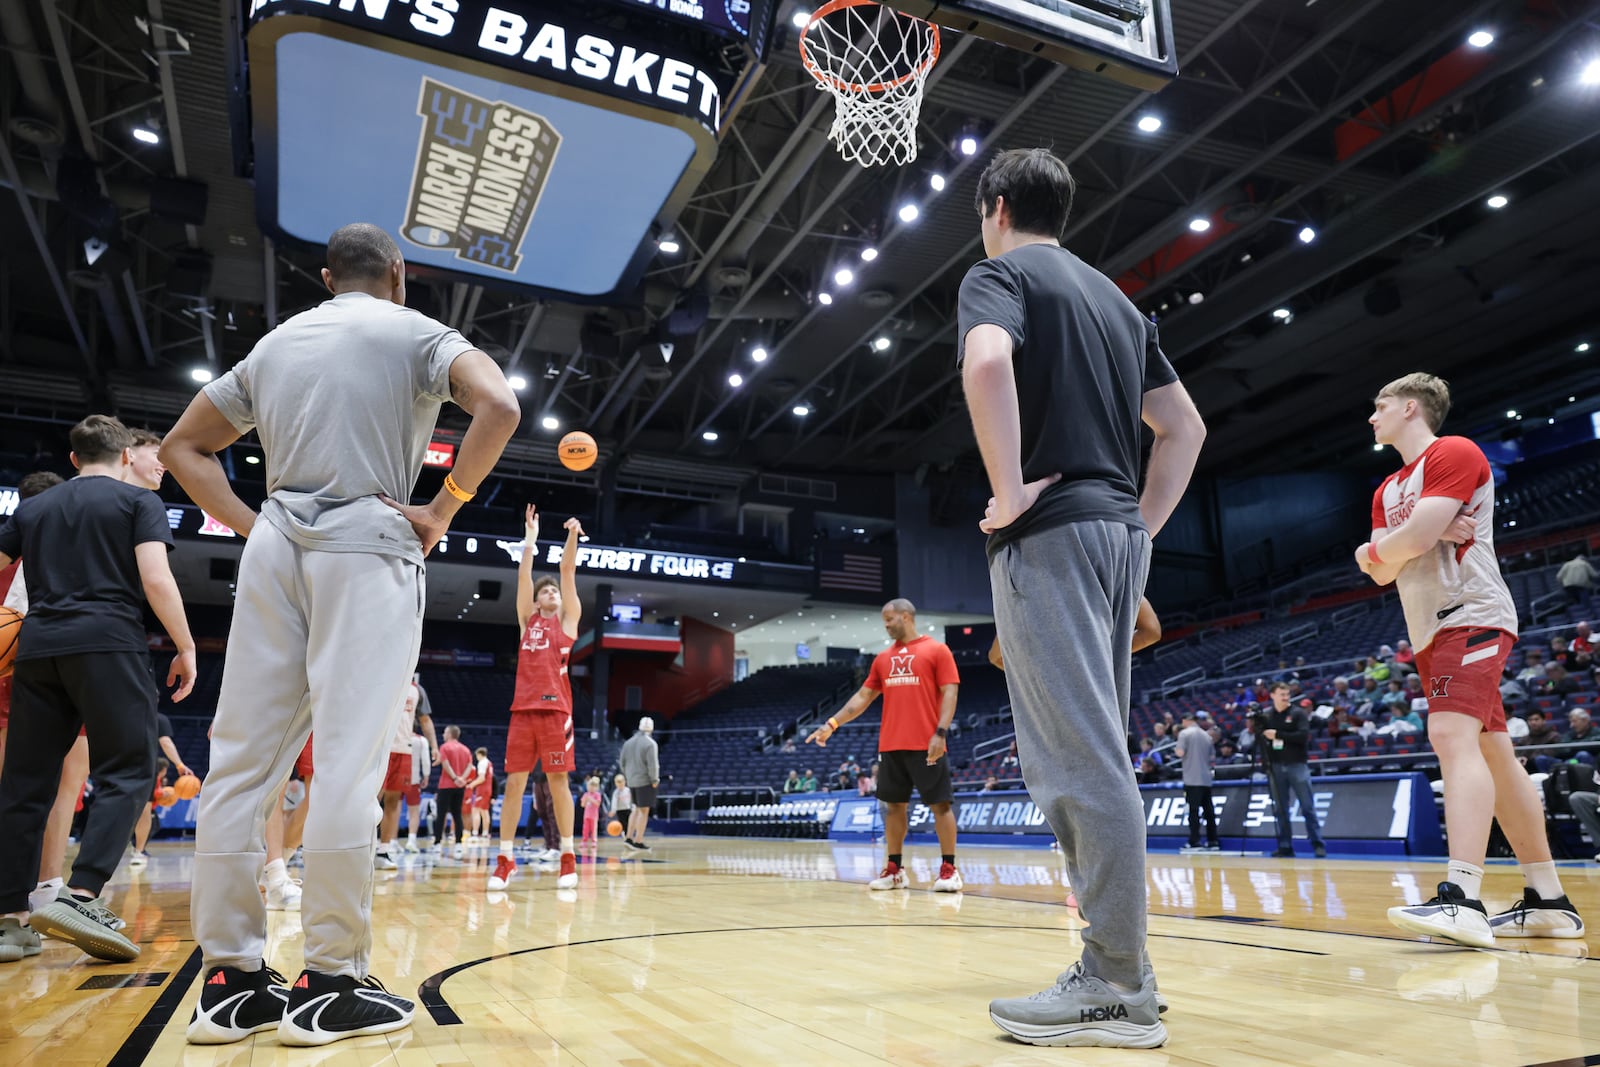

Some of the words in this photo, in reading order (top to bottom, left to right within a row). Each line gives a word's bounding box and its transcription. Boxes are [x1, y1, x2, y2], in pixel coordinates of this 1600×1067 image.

[415, 141, 477, 233] MARCH
[463, 108, 541, 235] MADNESS
[575, 547, 646, 572] FIRST
[650, 555, 710, 578] FOUR
[889, 654, 915, 677] M
[957, 802, 993, 827] THE
[992, 802, 1045, 826] ROAD
[1147, 796, 1227, 826] HEE
[1080, 1003, 1129, 1023] HOKA
